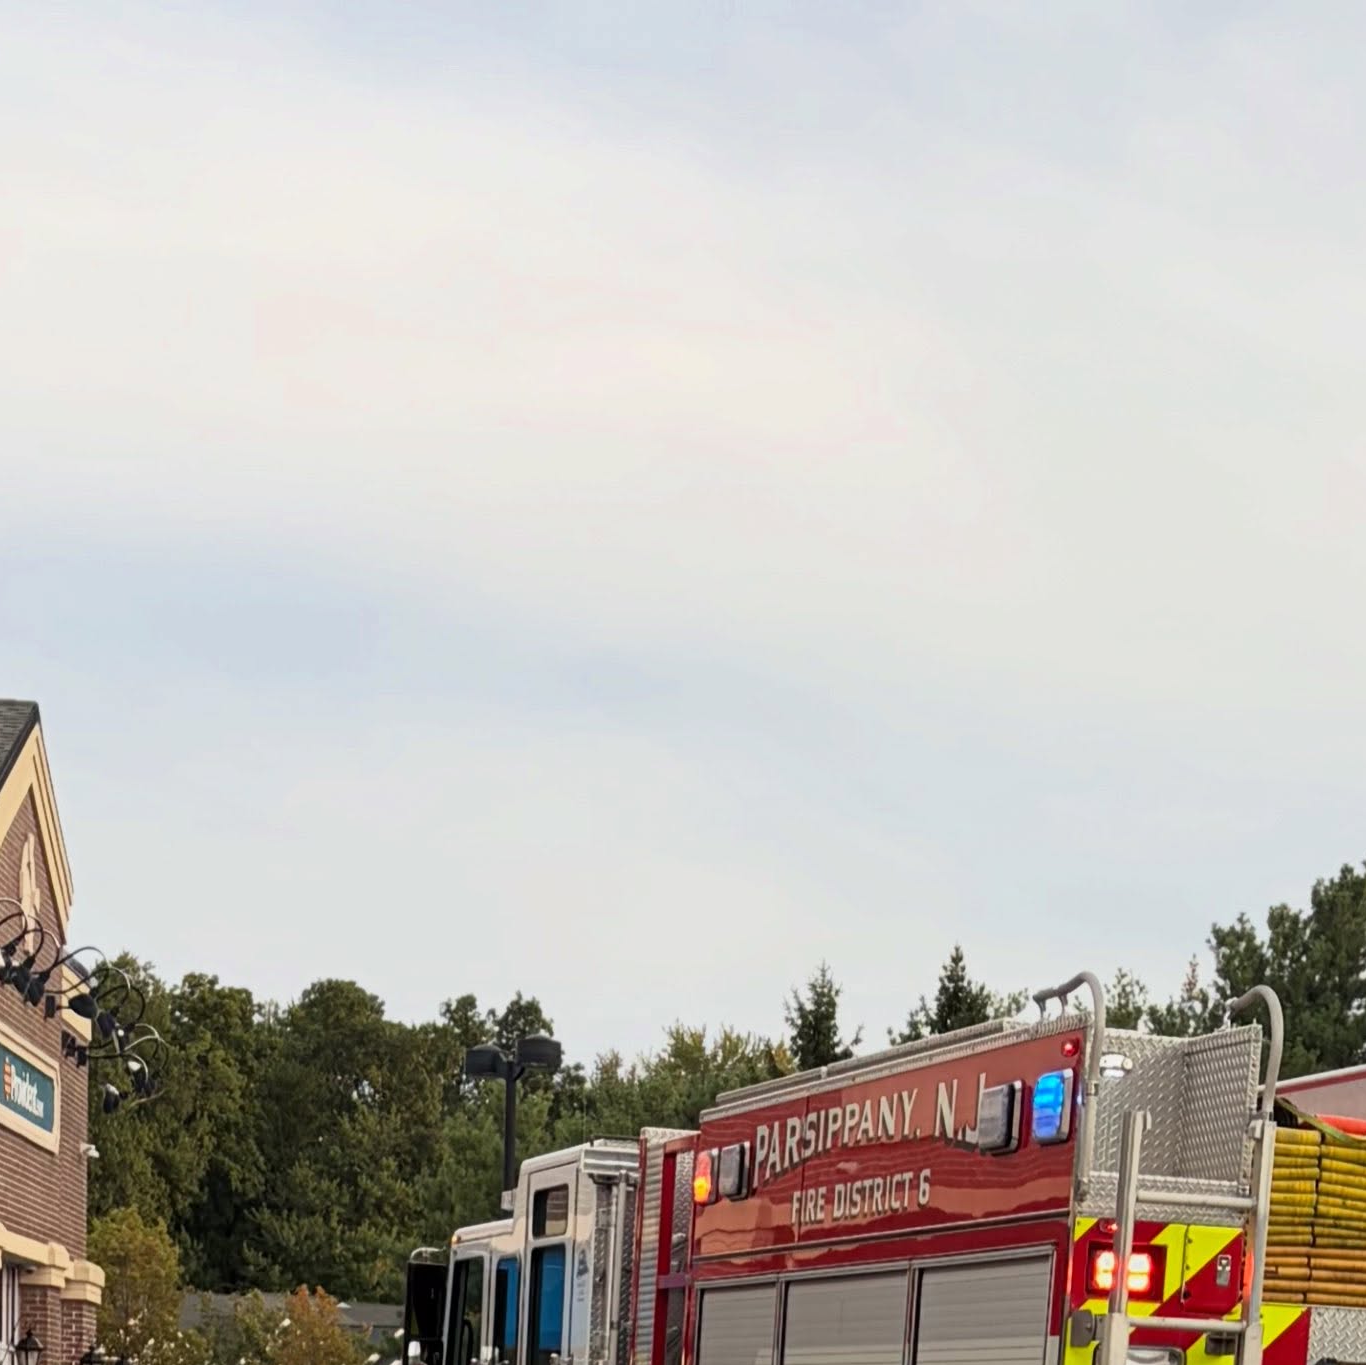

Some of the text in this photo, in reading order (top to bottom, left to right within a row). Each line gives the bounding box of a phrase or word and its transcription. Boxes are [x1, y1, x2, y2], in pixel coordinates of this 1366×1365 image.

[791, 1168, 931, 1224] FIRE DISTRICT 6
